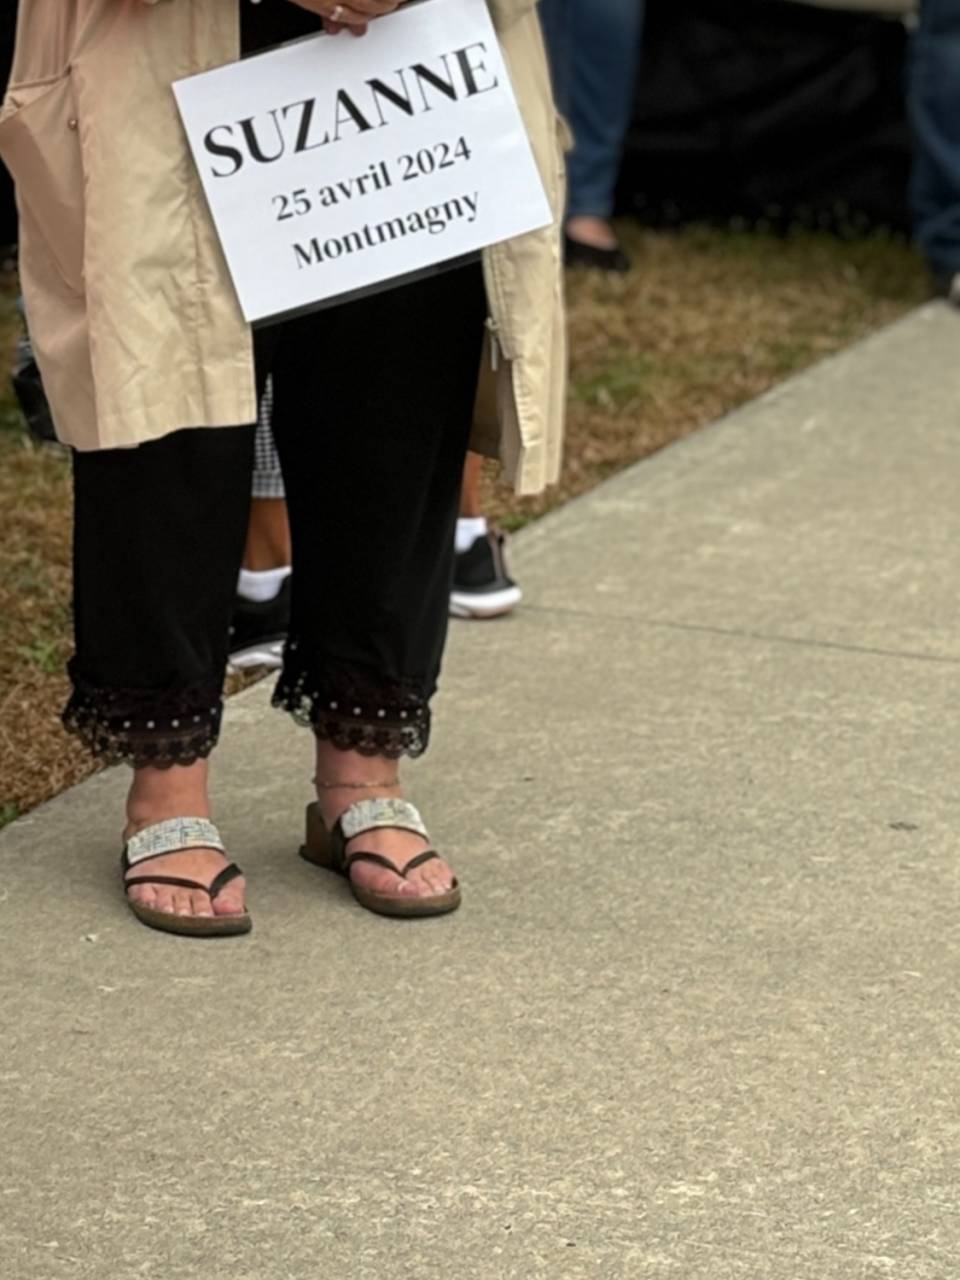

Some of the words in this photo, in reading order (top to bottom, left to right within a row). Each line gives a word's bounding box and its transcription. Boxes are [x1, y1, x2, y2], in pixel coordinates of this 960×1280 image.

[203, 41, 500, 179] SUZANNE
[271, 187, 312, 221] 25
[318, 160, 393, 208] avril
[396, 135, 473, 182] 2024
[291, 191, 481, 269] Montmagny
